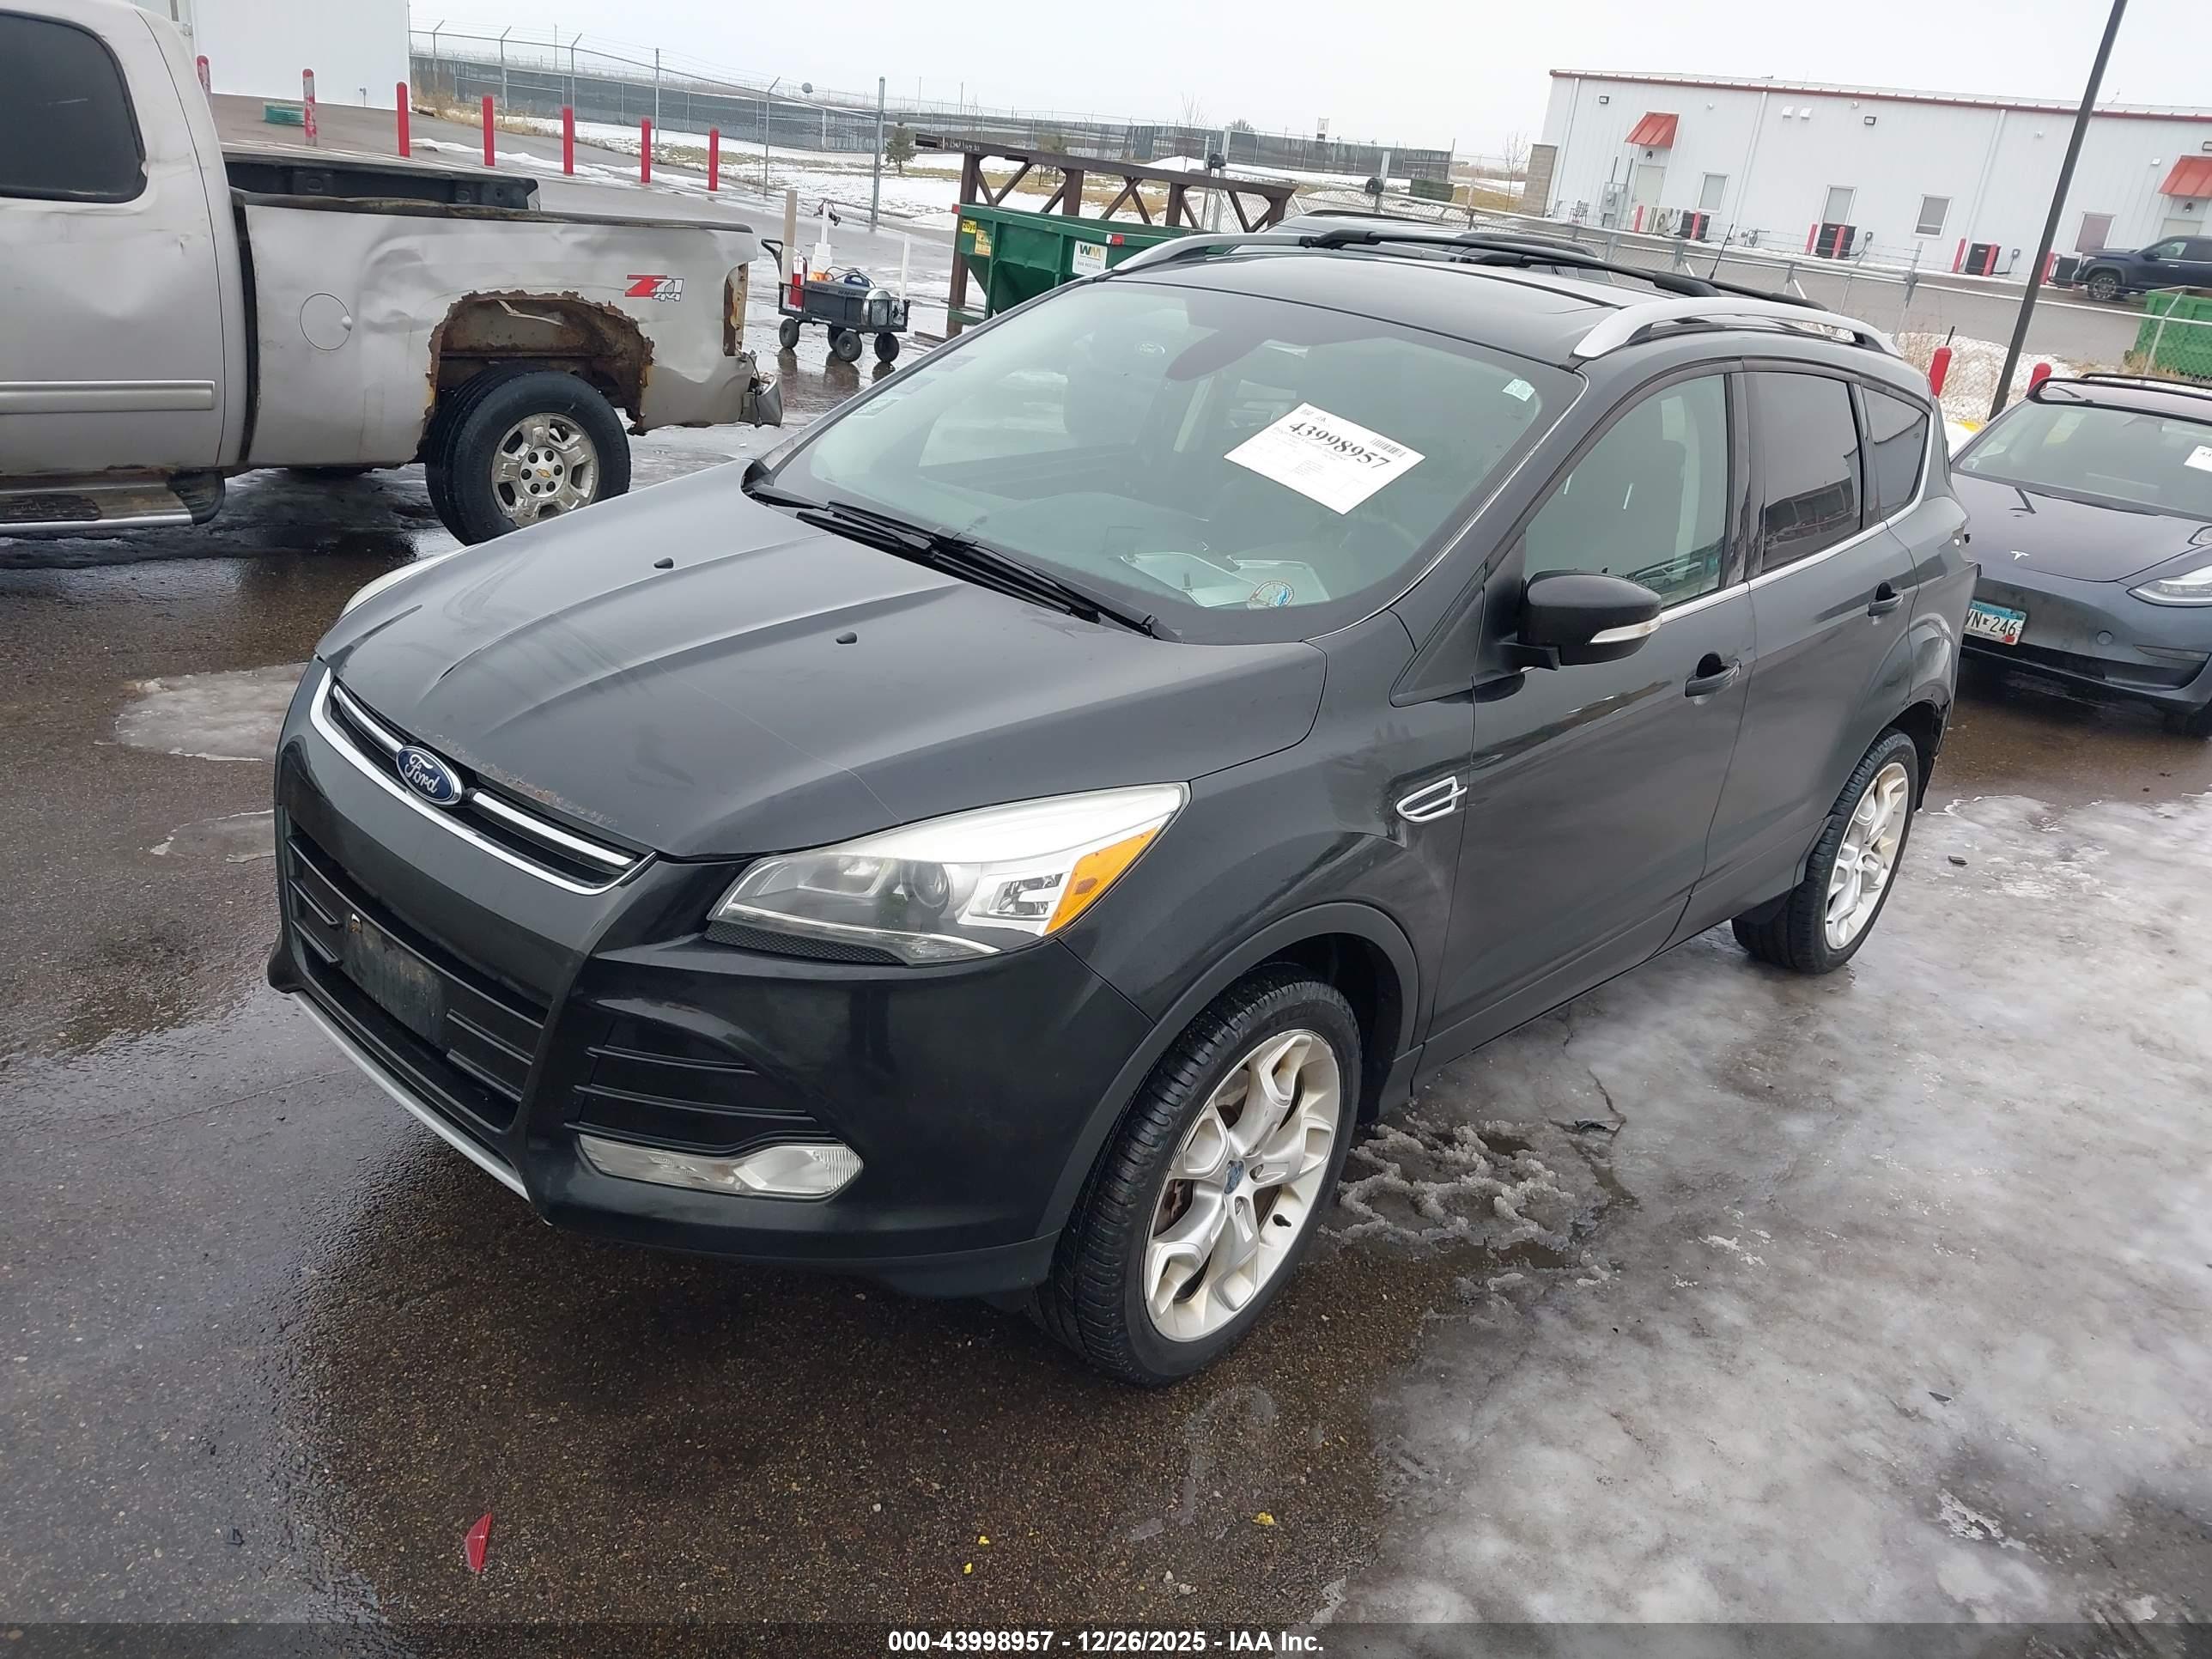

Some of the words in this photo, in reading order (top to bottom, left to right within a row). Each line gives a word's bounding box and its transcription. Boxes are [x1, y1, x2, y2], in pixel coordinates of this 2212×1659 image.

[1079, 244, 1101, 258] WM
[625, 274, 684, 298] Z71
[1289, 422, 1391, 469] 43998957
[1990, 616, 2017, 636] 246
[404, 754, 441, 793] Ford
